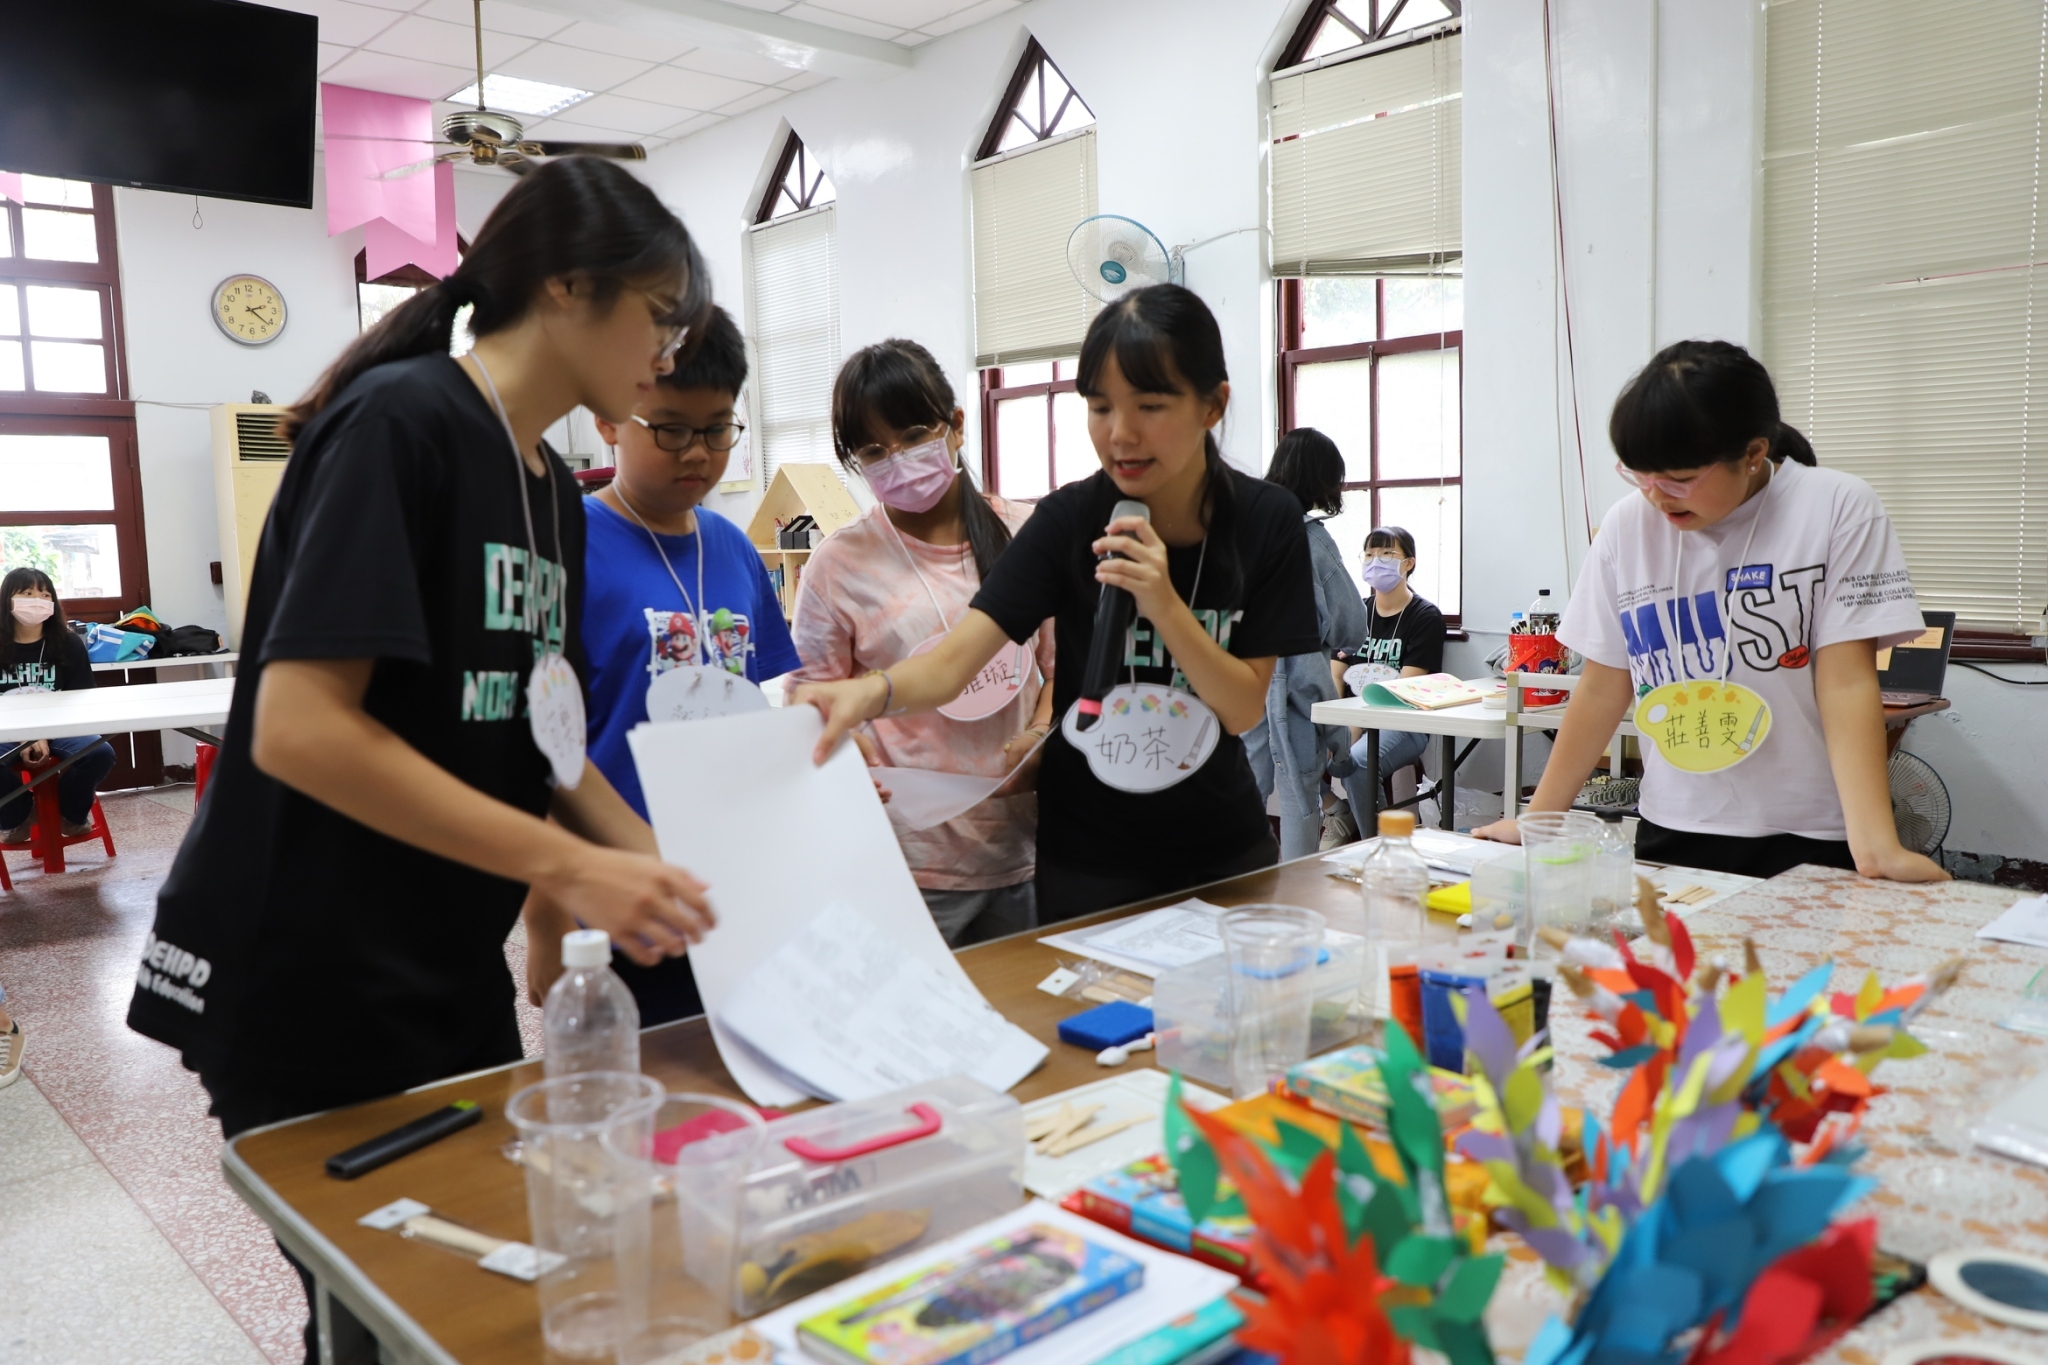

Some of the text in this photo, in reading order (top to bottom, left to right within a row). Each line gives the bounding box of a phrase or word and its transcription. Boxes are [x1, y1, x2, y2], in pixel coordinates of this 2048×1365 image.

[244, 284, 253, 293] 12
[266, 296, 272, 304] 2
[1730, 570, 1766, 582] SHAKE
[1620, 564, 1826, 683] MUST
[1354, 636, 1402, 660] EHPD
[1095, 726, 1174, 770] 奶茶
